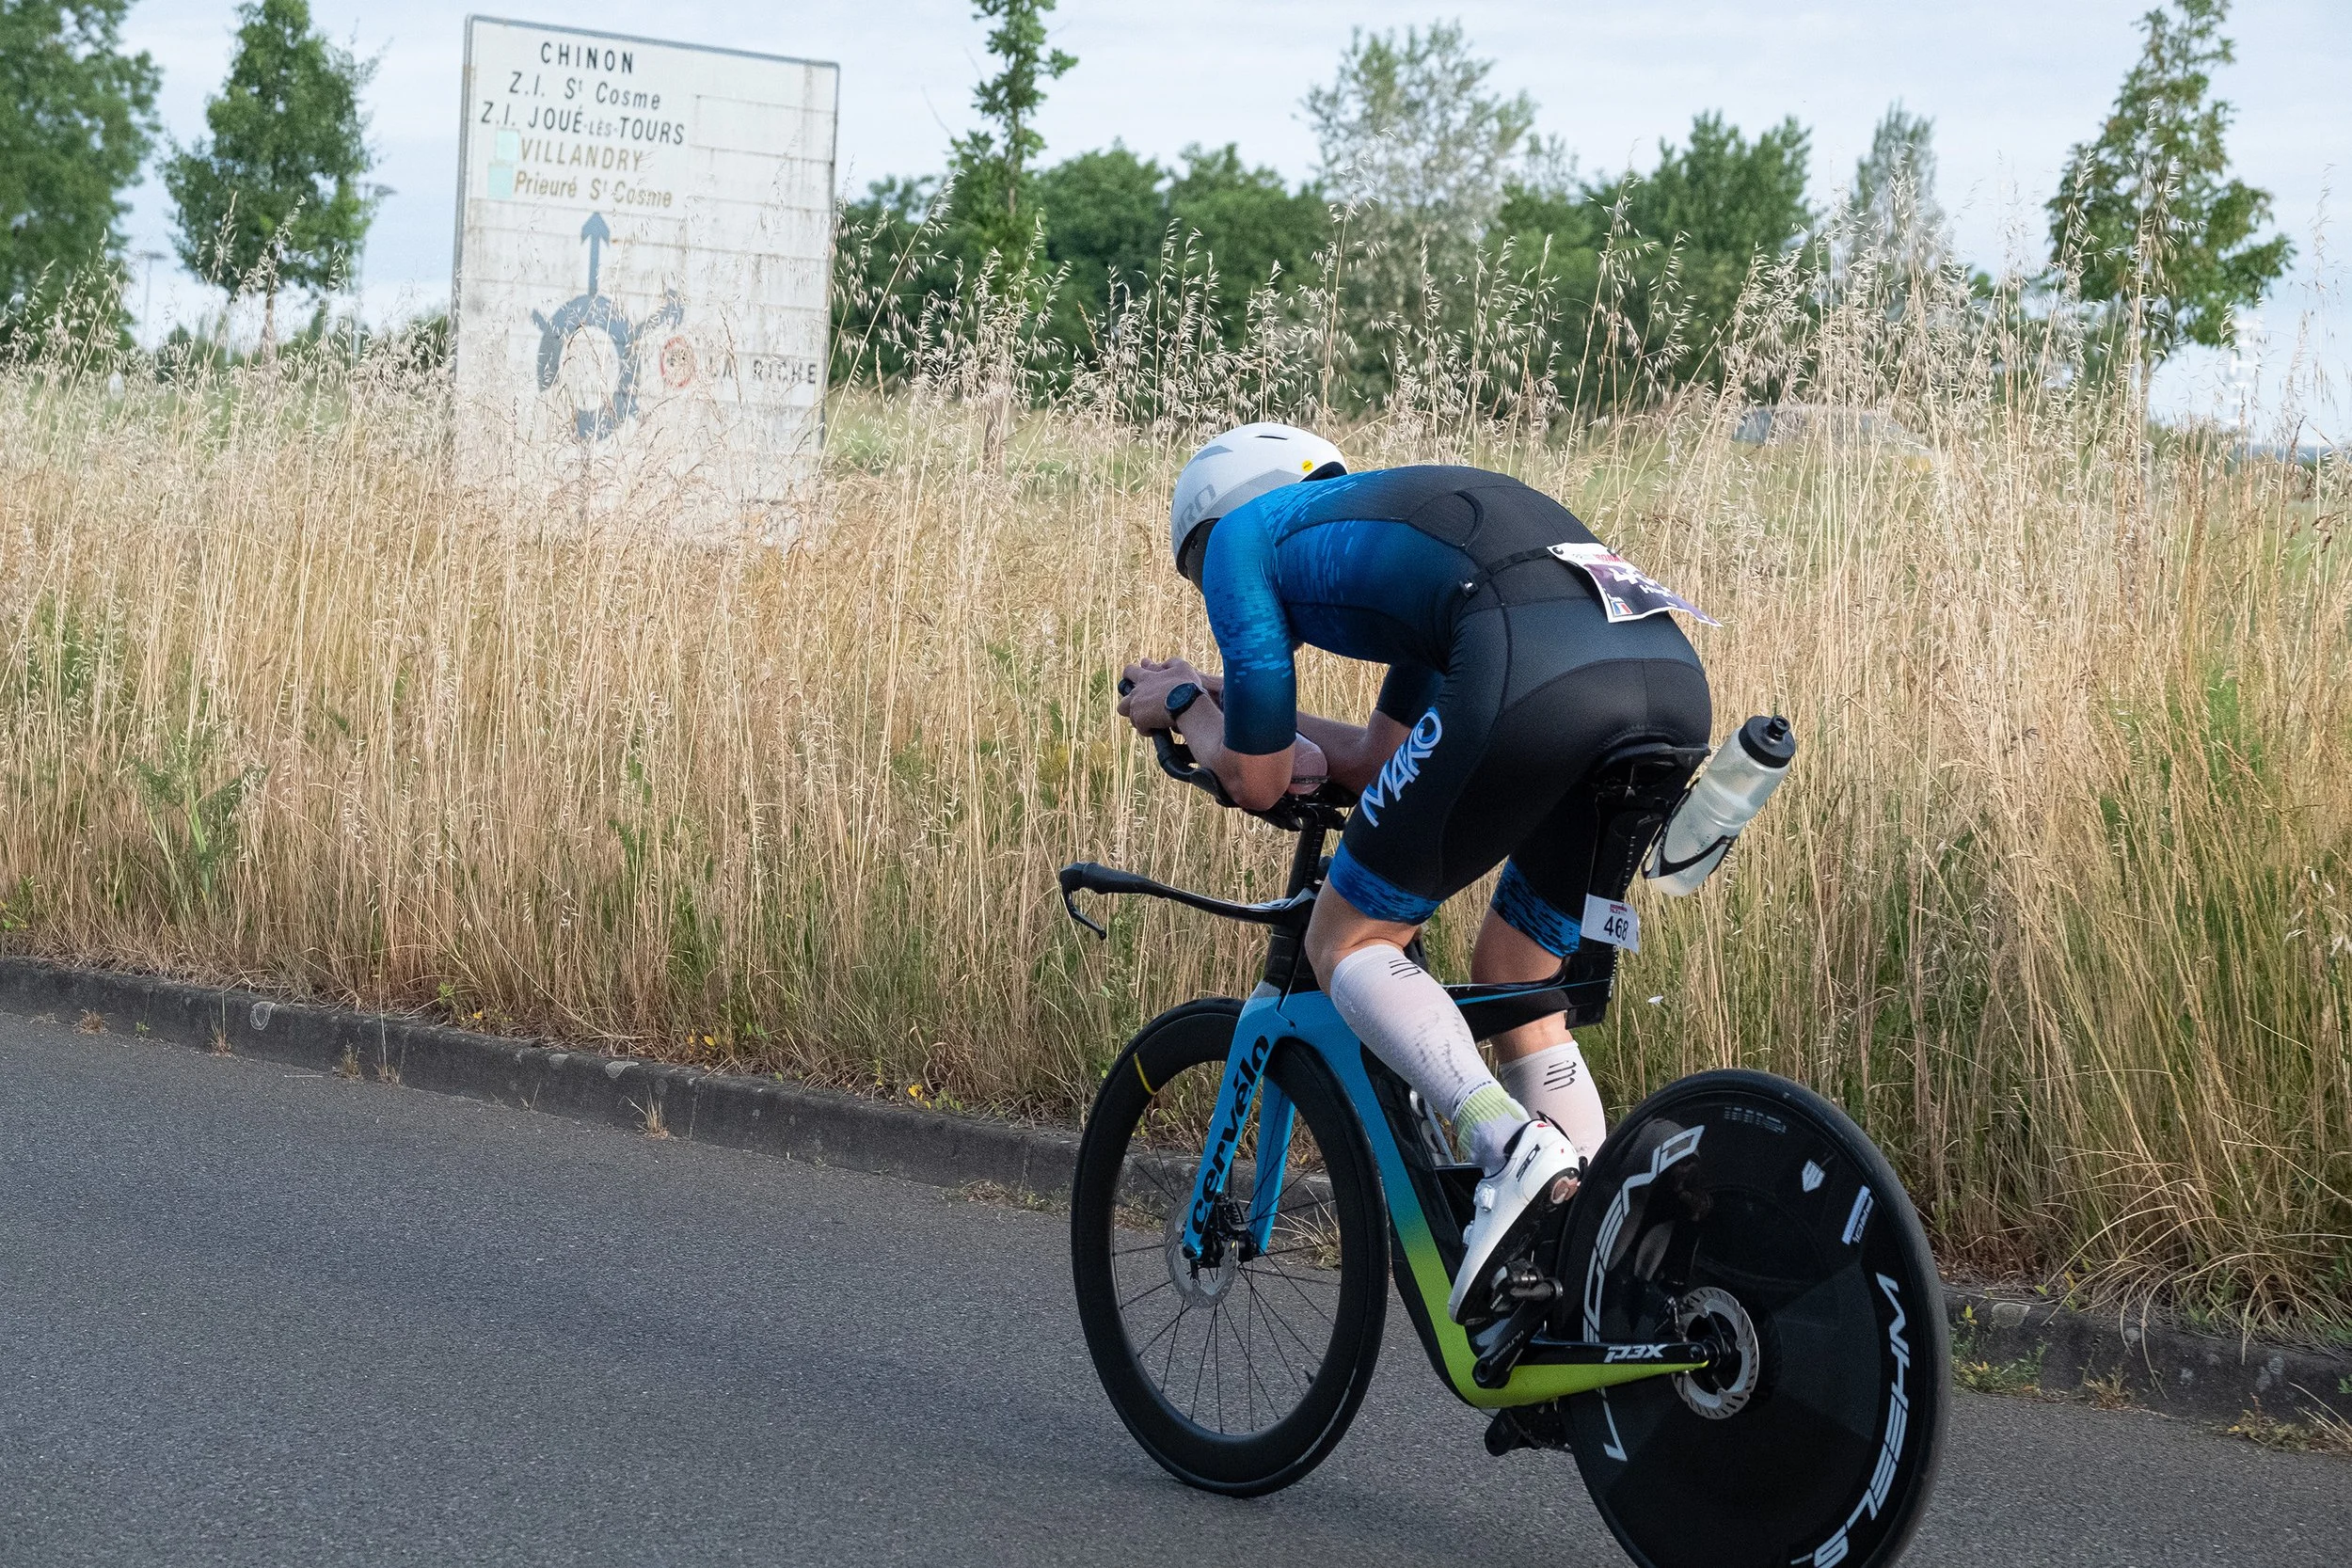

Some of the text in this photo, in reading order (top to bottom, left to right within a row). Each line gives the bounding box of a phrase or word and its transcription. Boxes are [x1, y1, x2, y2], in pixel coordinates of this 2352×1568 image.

[540, 41, 633, 74] CHINON
[509, 71, 545, 98] Z.I.
[596, 81, 661, 110] Cosme
[481, 101, 516, 127] Z.I.
[520, 137, 644, 172] VILLANDRY
[514, 169, 578, 198] Prieuré
[613, 181, 673, 209] Cosme
[1360, 706, 1443, 828] MAKO
[1603, 915, 1629, 942] 468
[1603, 1343, 1669, 1364] P3X
[1814, 1272, 1910, 1568] WHEELS
